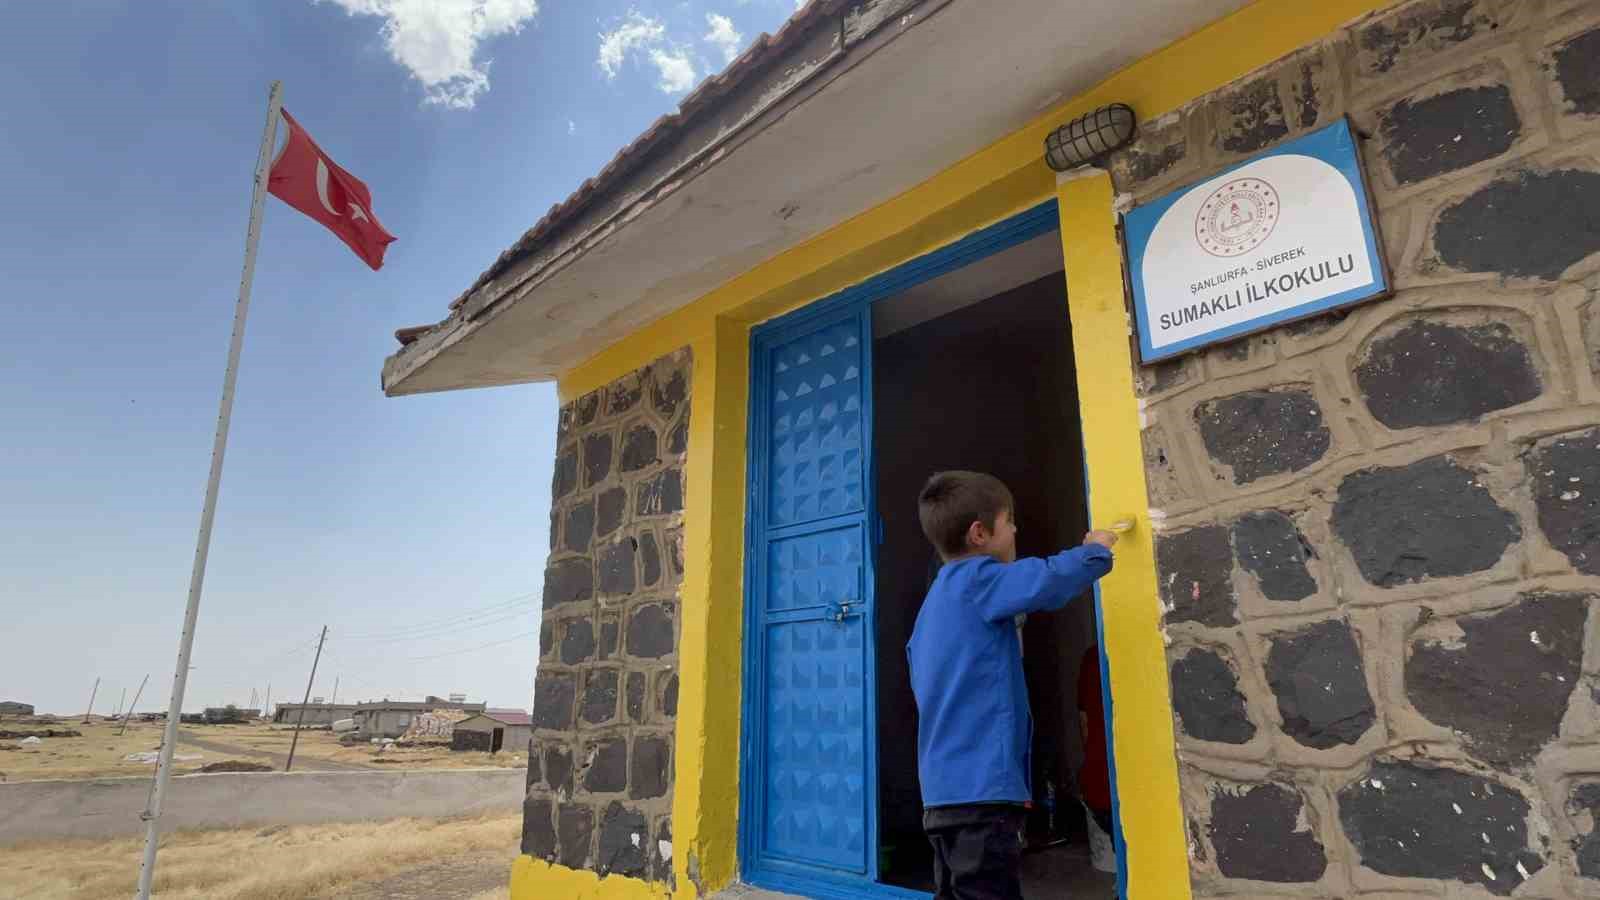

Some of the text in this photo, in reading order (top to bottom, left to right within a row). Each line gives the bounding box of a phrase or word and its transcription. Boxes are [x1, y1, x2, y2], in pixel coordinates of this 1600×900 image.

[1160, 254, 1355, 330] SUMAKLI İLKOKULU
[1190, 267, 1248, 295] ŞANLIURFA
[1256, 246, 1306, 272] SİVEREK
